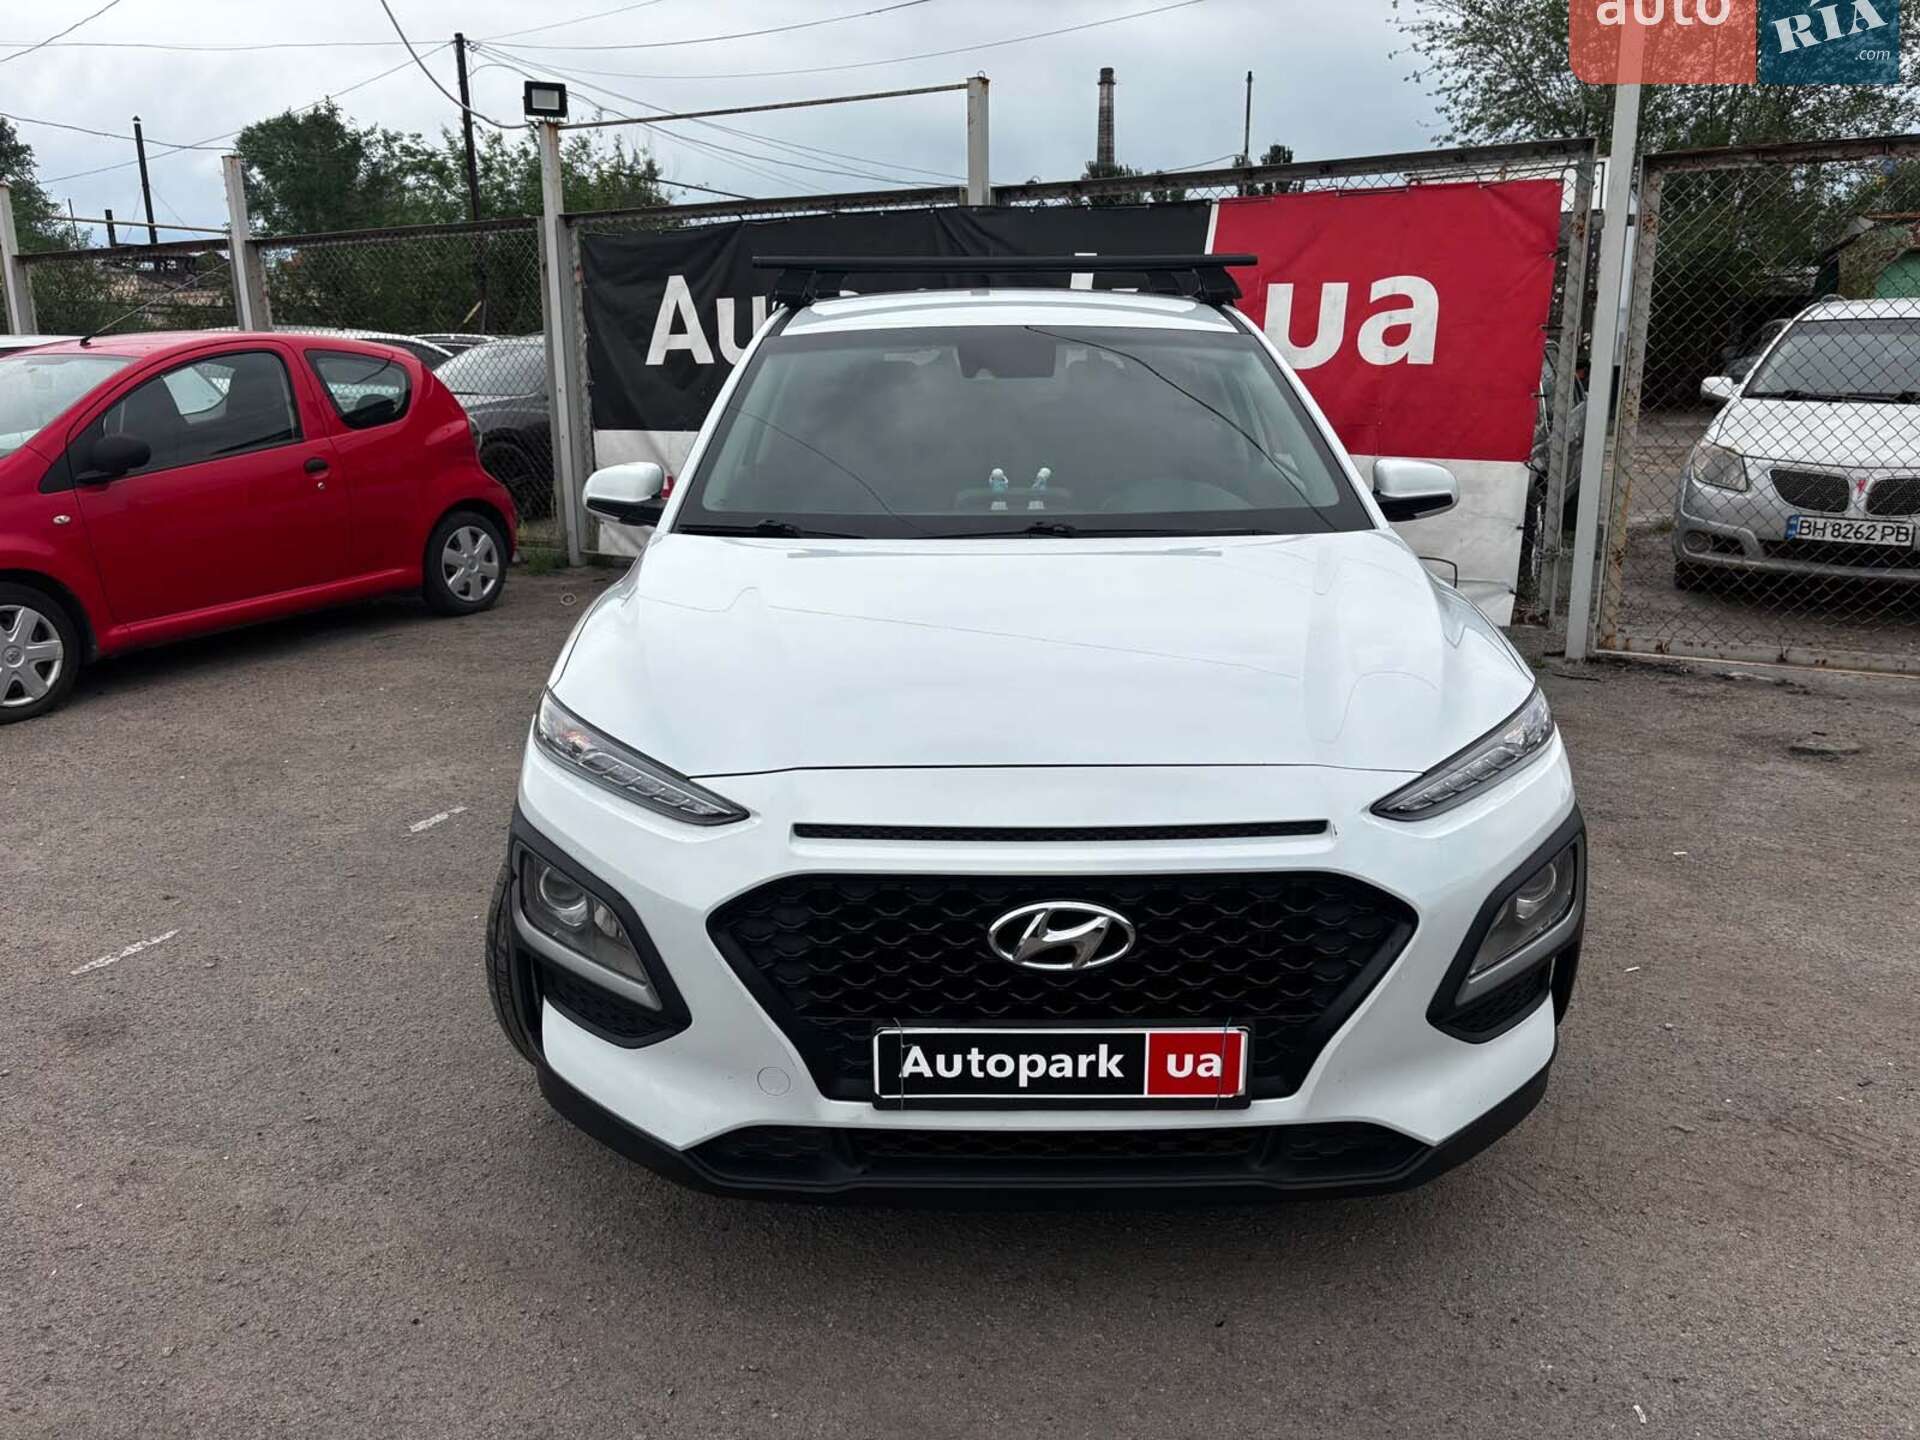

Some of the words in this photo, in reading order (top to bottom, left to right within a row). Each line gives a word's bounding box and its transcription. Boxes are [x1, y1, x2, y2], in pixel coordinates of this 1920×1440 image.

[1264, 275, 1439, 370] ua
[1831, 522, 1877, 541] 8262
[1880, 525, 1909, 542] PB
[901, 1044, 1125, 1088] Autopark
[1166, 1052, 1222, 1078] ua
